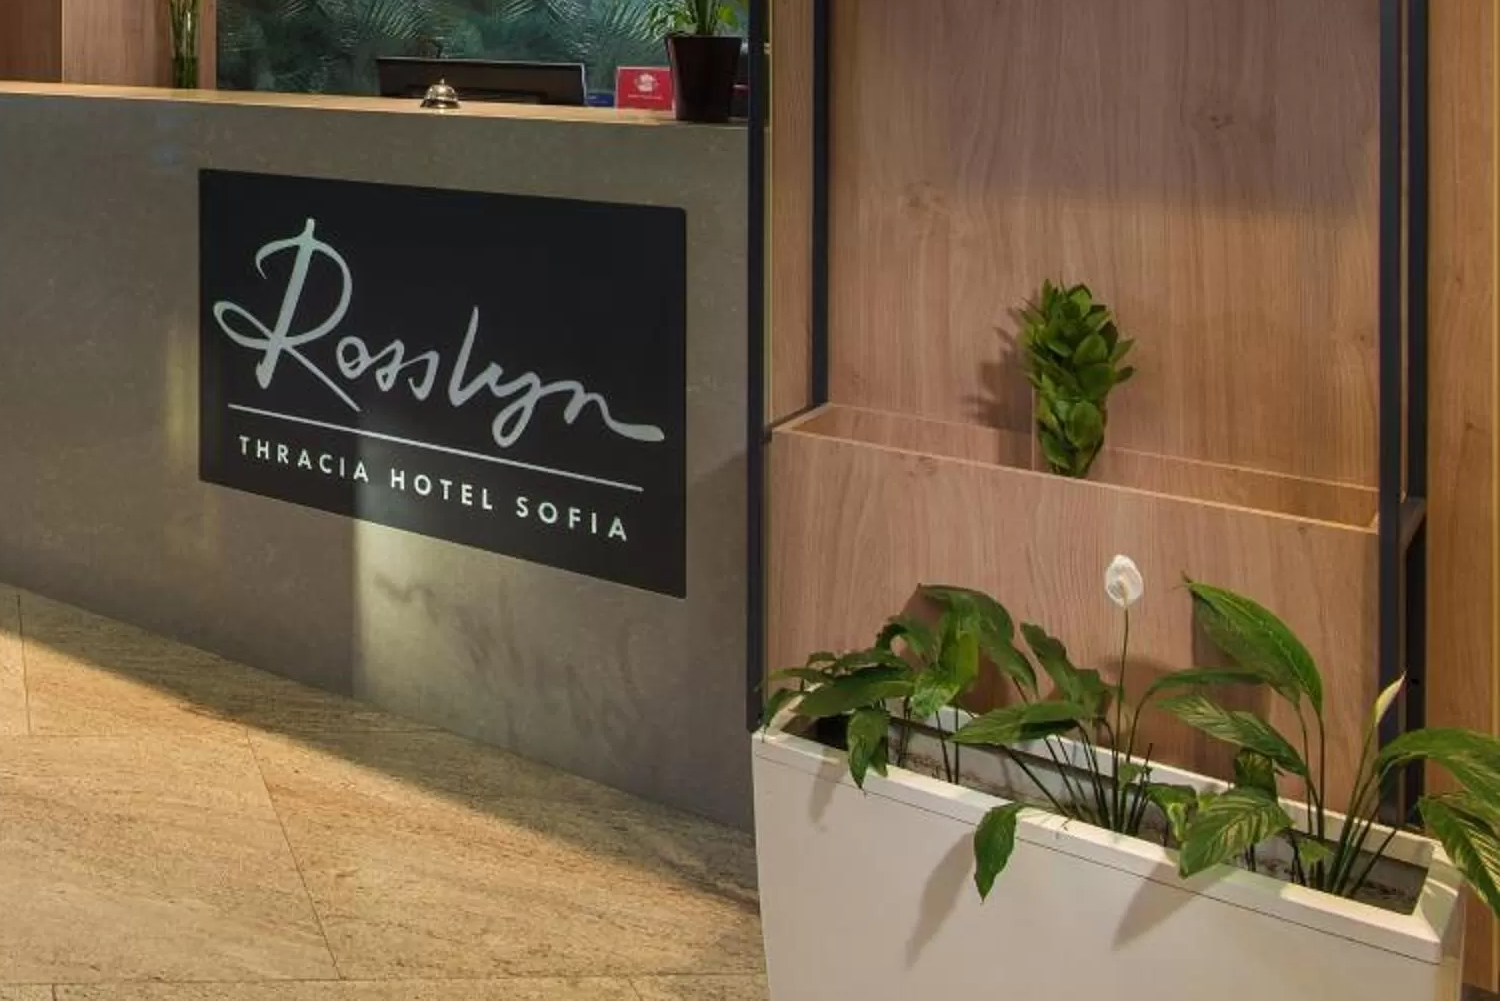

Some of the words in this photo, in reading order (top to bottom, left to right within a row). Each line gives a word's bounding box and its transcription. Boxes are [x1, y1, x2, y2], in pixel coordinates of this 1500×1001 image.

[212, 217, 666, 449] Rosslyn
[239, 435, 370, 484] THRACIA
[391, 468, 495, 512] HOTEL
[515, 495, 629, 542] SOFIA
